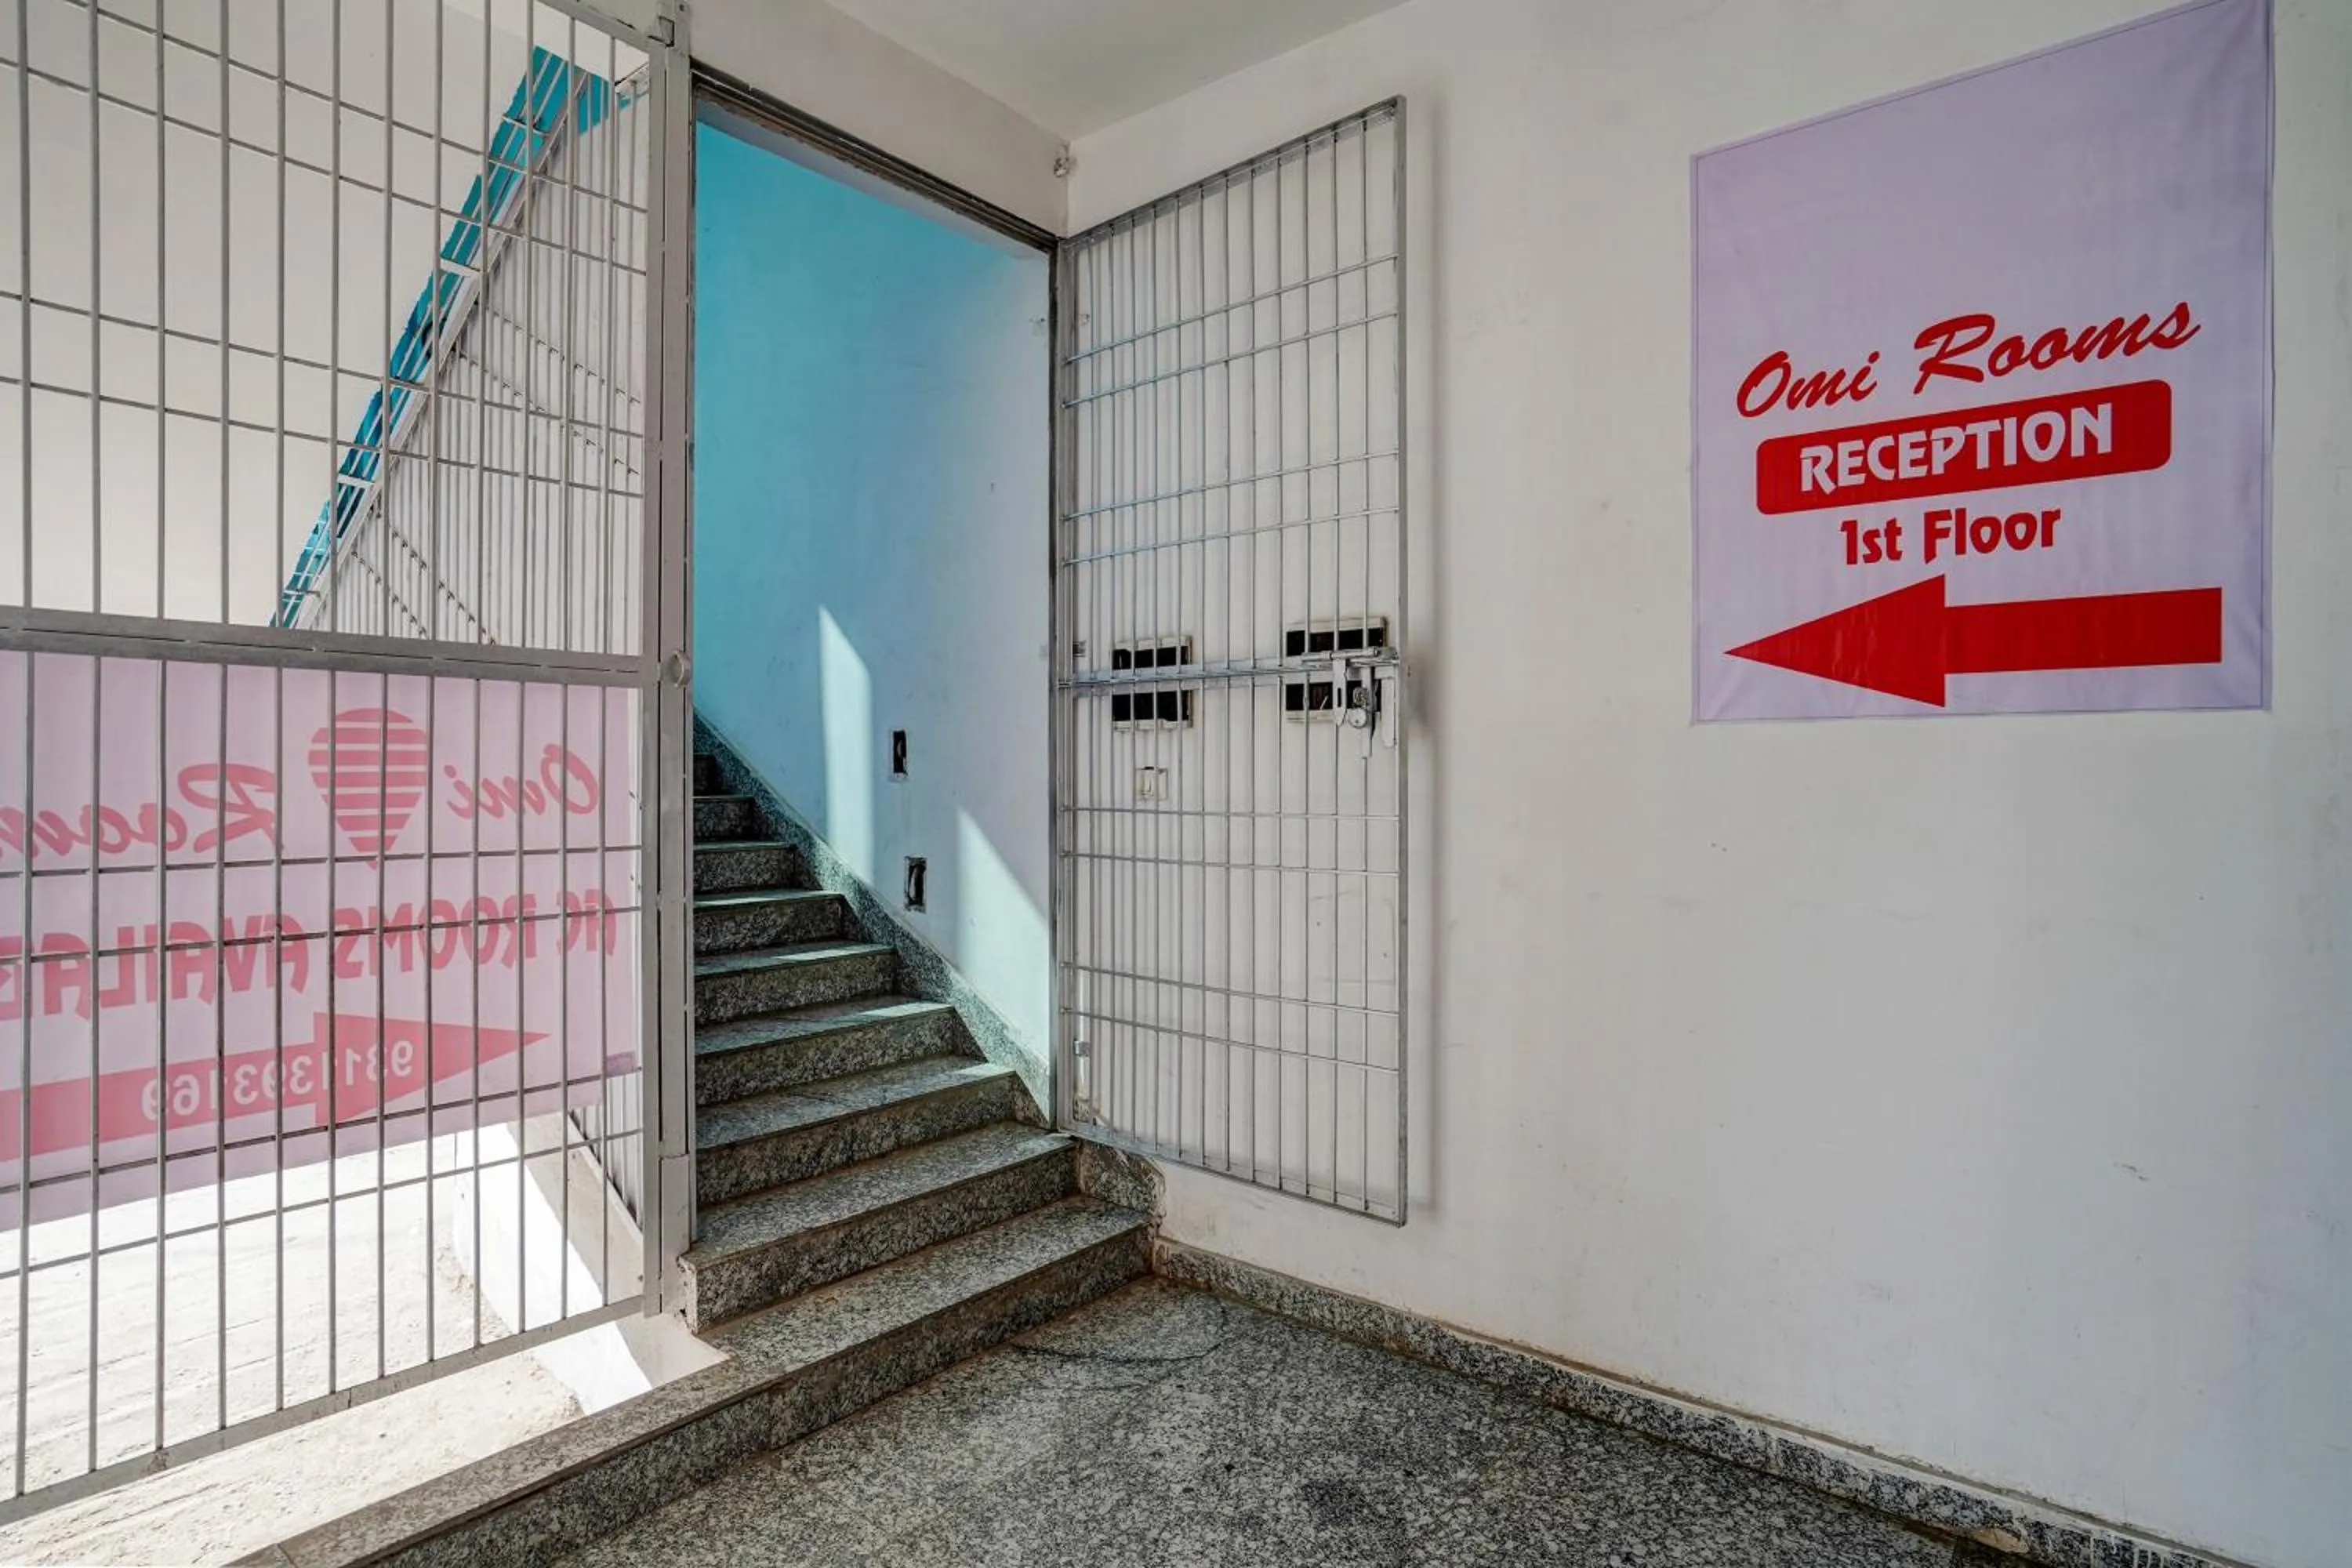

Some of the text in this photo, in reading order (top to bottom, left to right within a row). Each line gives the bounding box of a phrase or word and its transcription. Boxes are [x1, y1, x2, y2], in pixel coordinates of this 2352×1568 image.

[1736, 302, 2201, 418] Omi Rooms
[1800, 402, 2113, 495] RECEPTION
[1839, 507, 2062, 565] 1st Floor
